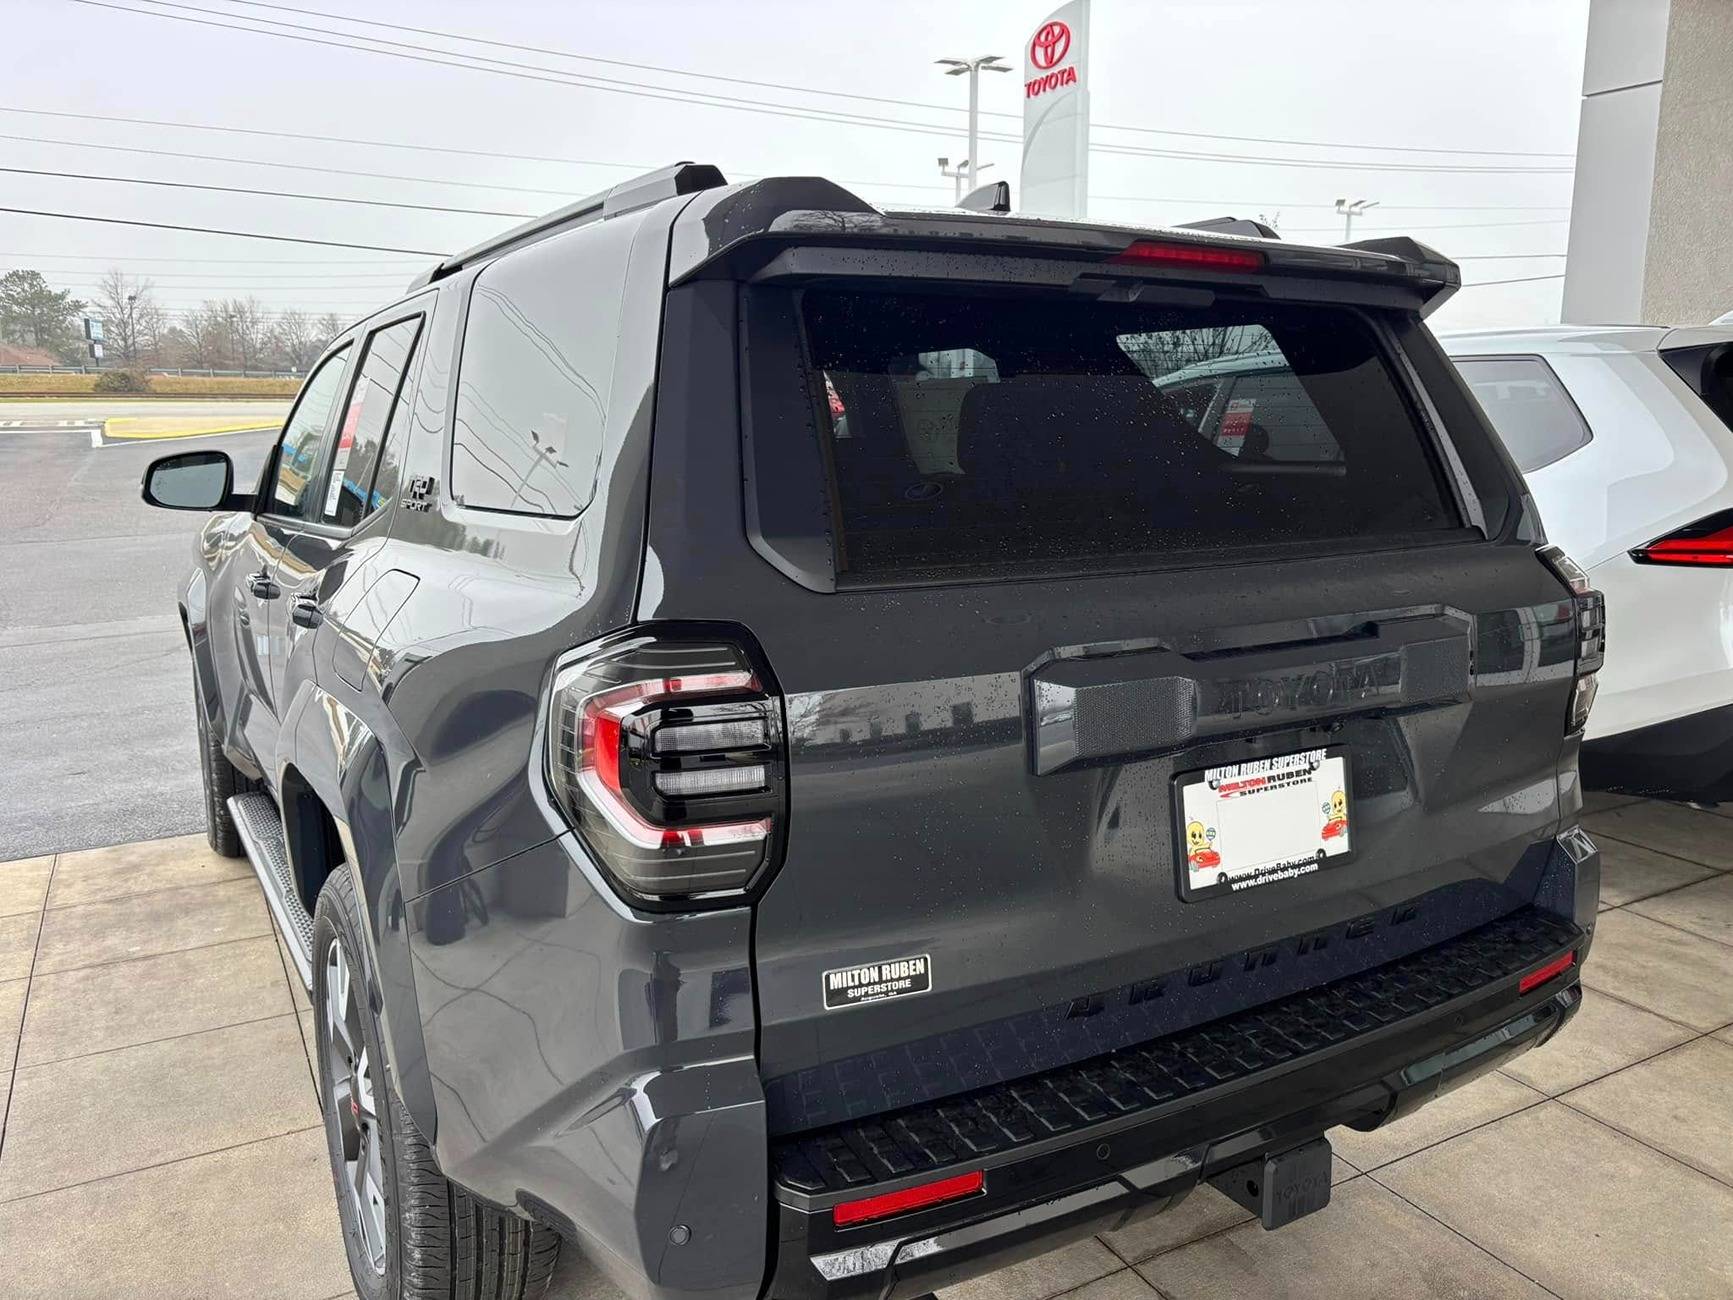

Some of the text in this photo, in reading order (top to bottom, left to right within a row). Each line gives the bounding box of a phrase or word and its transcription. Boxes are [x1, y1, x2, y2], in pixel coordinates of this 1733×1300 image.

[1025, 66, 1077, 98] TOYOTA
[401, 499, 428, 511] SPORT
[1216, 661, 1380, 719] TOYOTA
[1204, 748, 1328, 782] MILTON RUBEN SUPERSTORE
[1218, 767, 1313, 793] MILTON RUBEN
[1239, 777, 1313, 796] SUPERSTORE
[1231, 863, 1318, 891] www.drivebaby.com
[829, 958, 925, 990] MILTON RUBEN
[847, 978, 911, 998] SUPERSTORE
